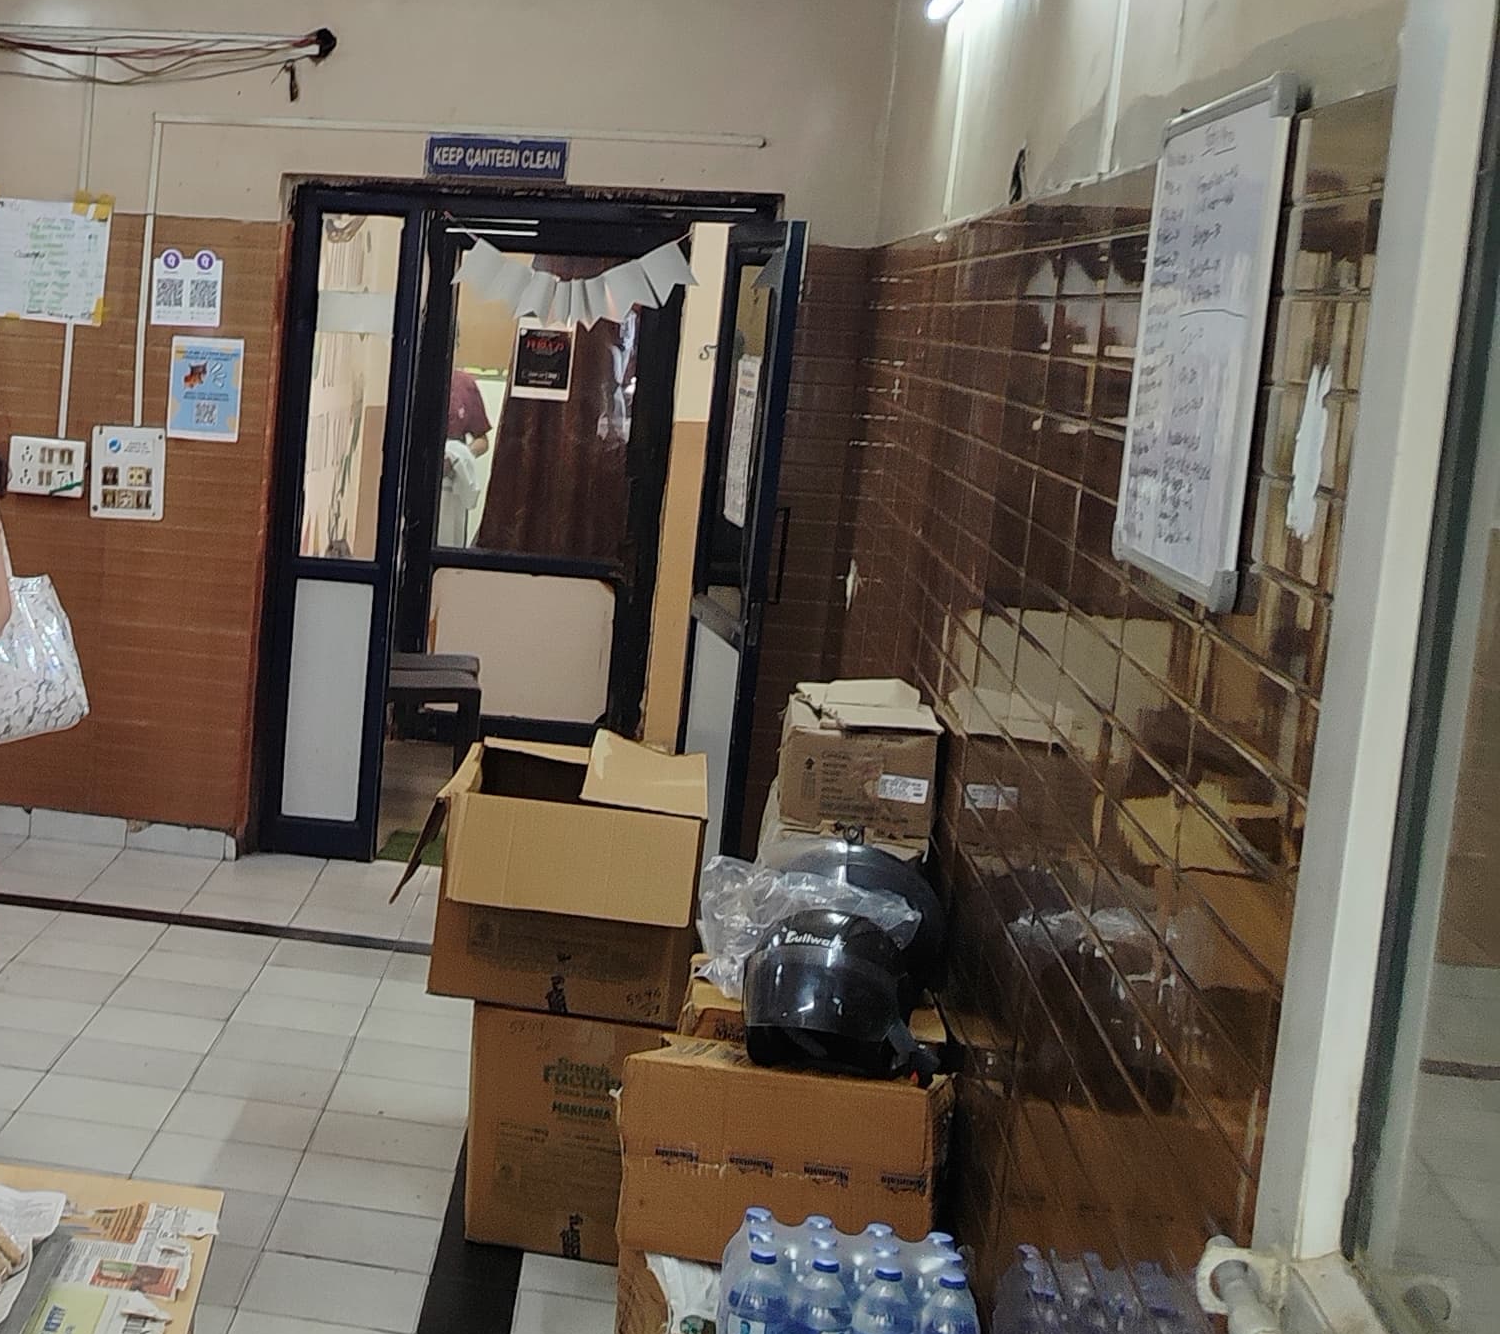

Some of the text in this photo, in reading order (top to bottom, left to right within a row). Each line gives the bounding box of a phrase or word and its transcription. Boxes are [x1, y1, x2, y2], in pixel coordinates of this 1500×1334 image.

[432, 146, 561, 171] KEEP CANTEEN CLEAN
